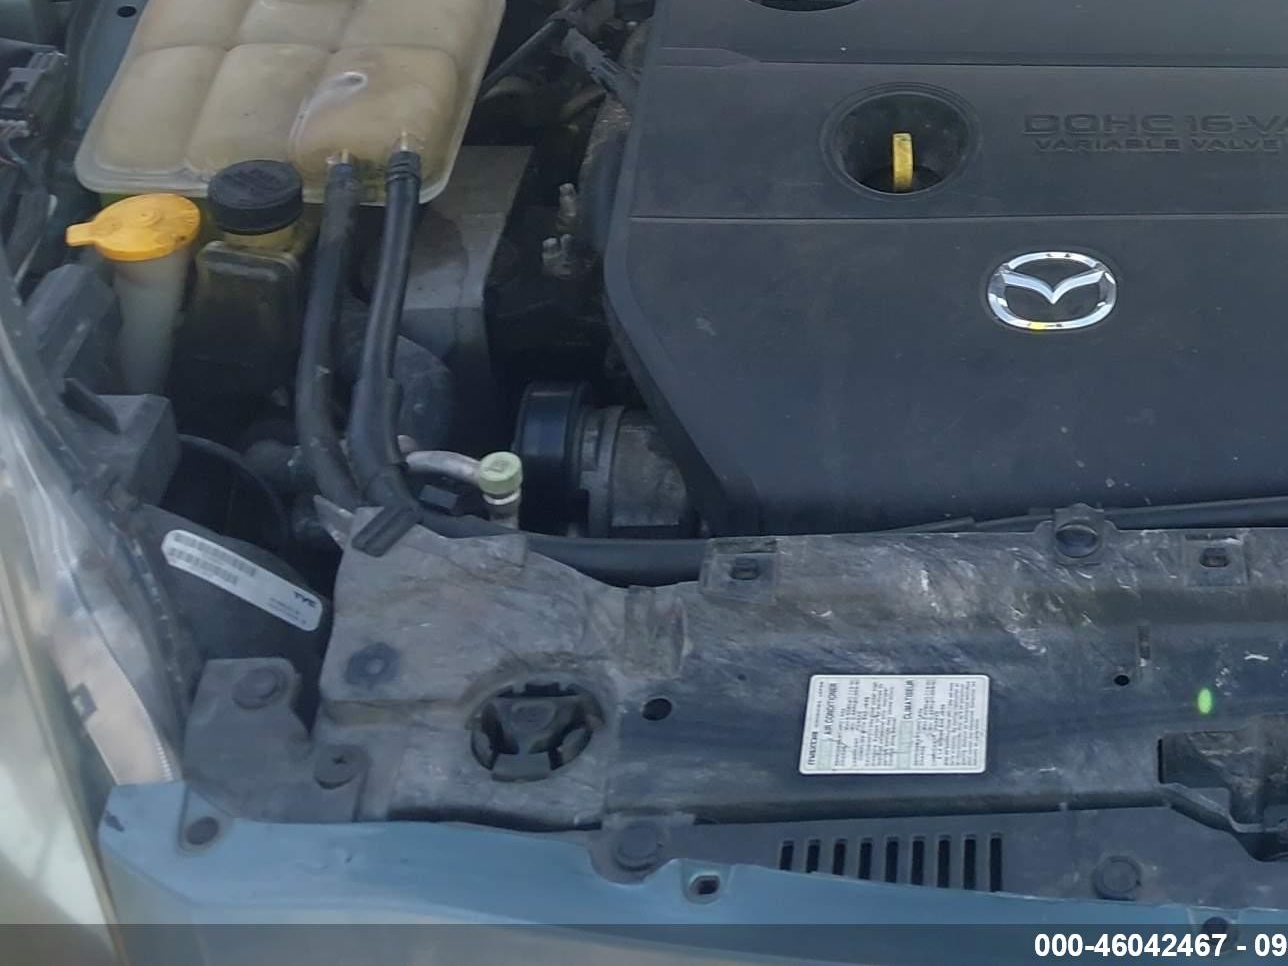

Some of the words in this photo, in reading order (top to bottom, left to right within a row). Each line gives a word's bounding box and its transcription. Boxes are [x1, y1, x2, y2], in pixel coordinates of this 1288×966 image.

[1023, 114, 1176, 135] DOHC
[1035, 137, 1181, 153] VARIABLE
[1191, 137, 1280, 153] VALVE
